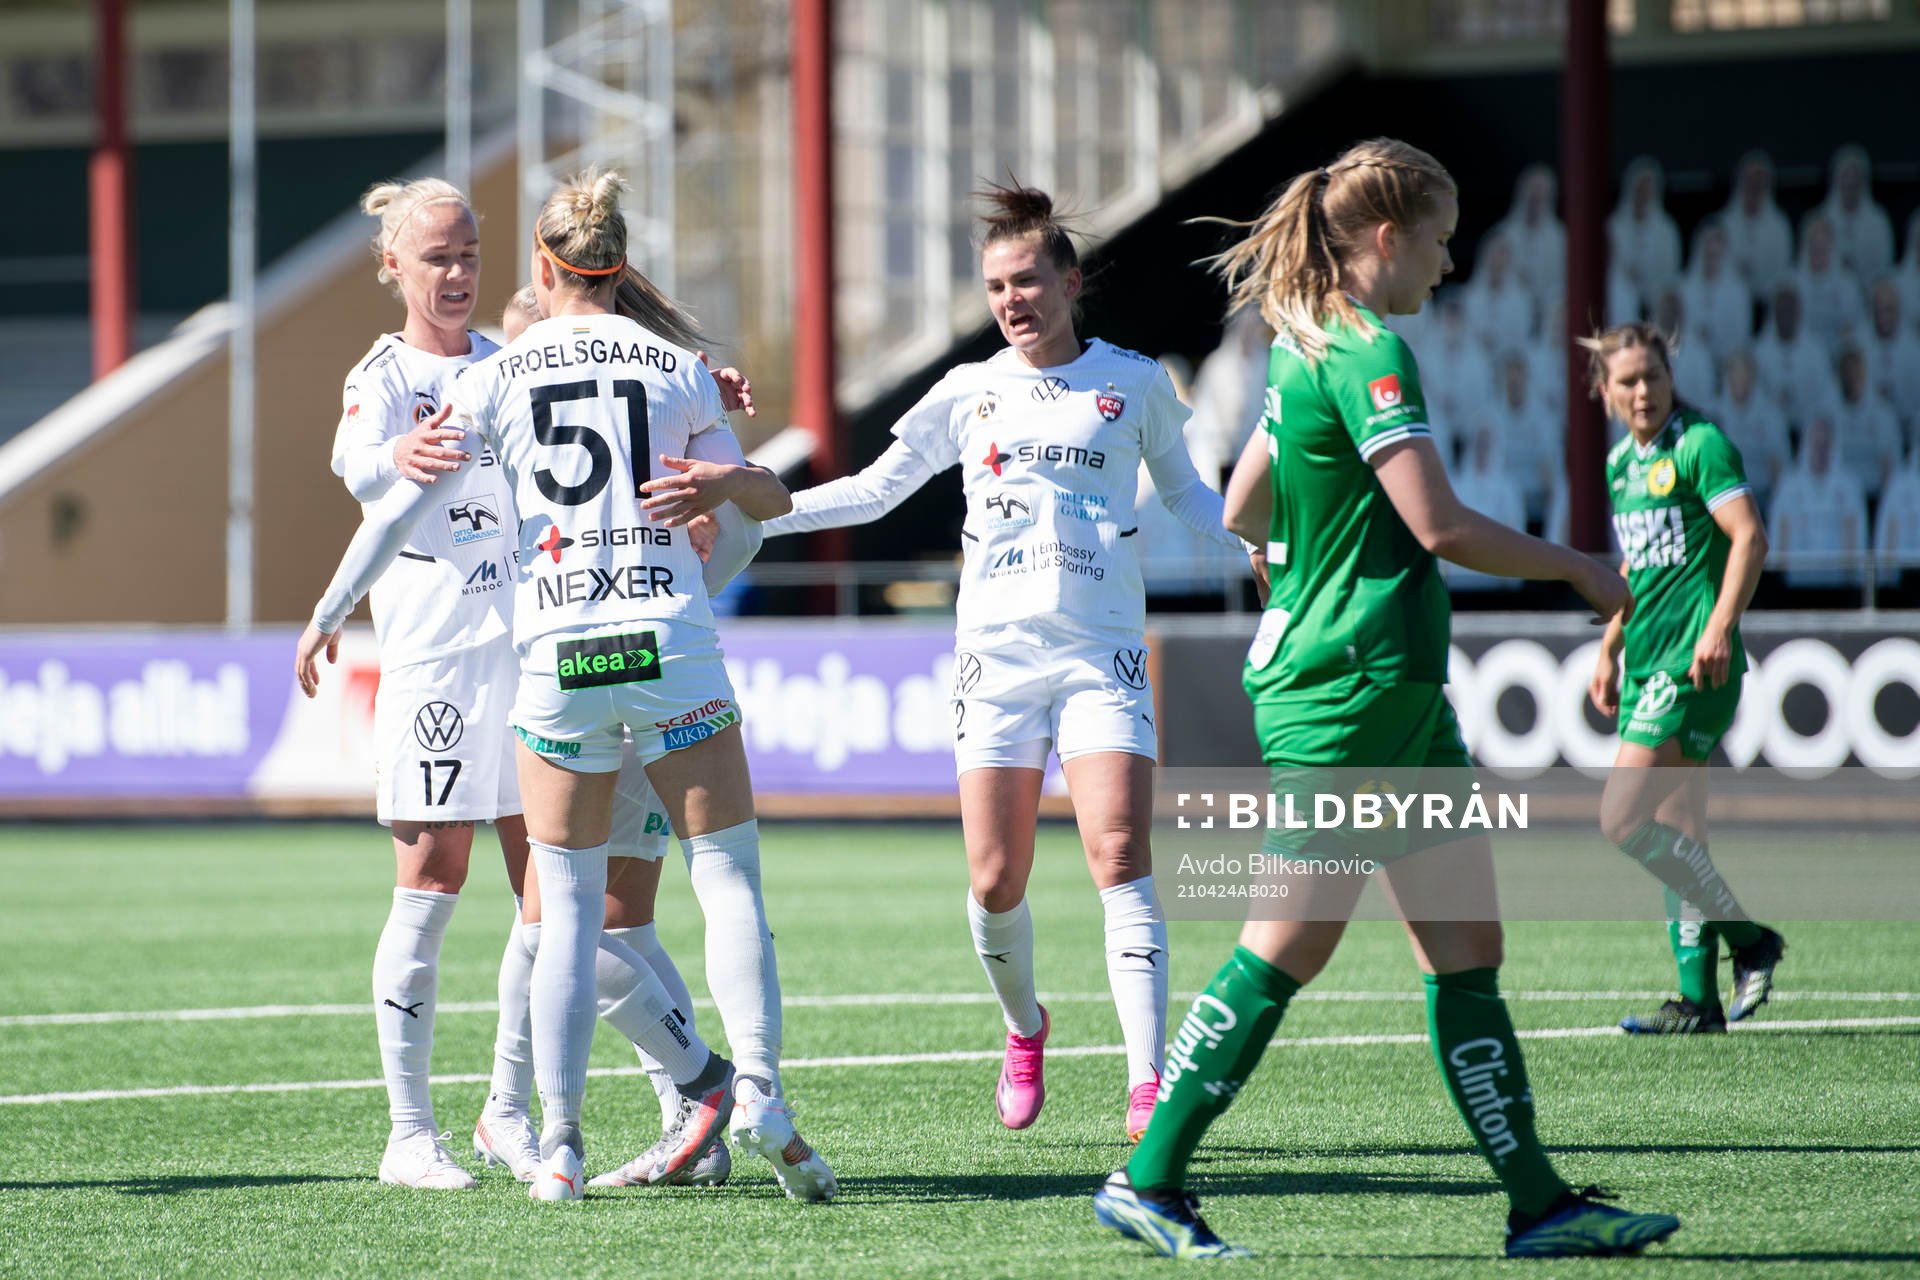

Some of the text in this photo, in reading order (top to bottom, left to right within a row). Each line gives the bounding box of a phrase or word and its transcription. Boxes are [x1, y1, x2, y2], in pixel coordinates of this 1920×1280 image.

[498, 339, 677, 379] TROELSGAARD
[530, 378, 653, 506] 51
[453, 528, 473, 539] OTTO
[454, 529, 501, 545] MAGNUSSON
[1040, 540, 1097, 564] Embassy
[1054, 555, 1105, 581] Sharing
[559, 651, 626, 677] akea
[668, 725, 708, 747] MKB
[420, 760, 462, 806] 17
[1157, 993, 1238, 1103] Clinton
[1450, 1036, 1519, 1158] Clinton
